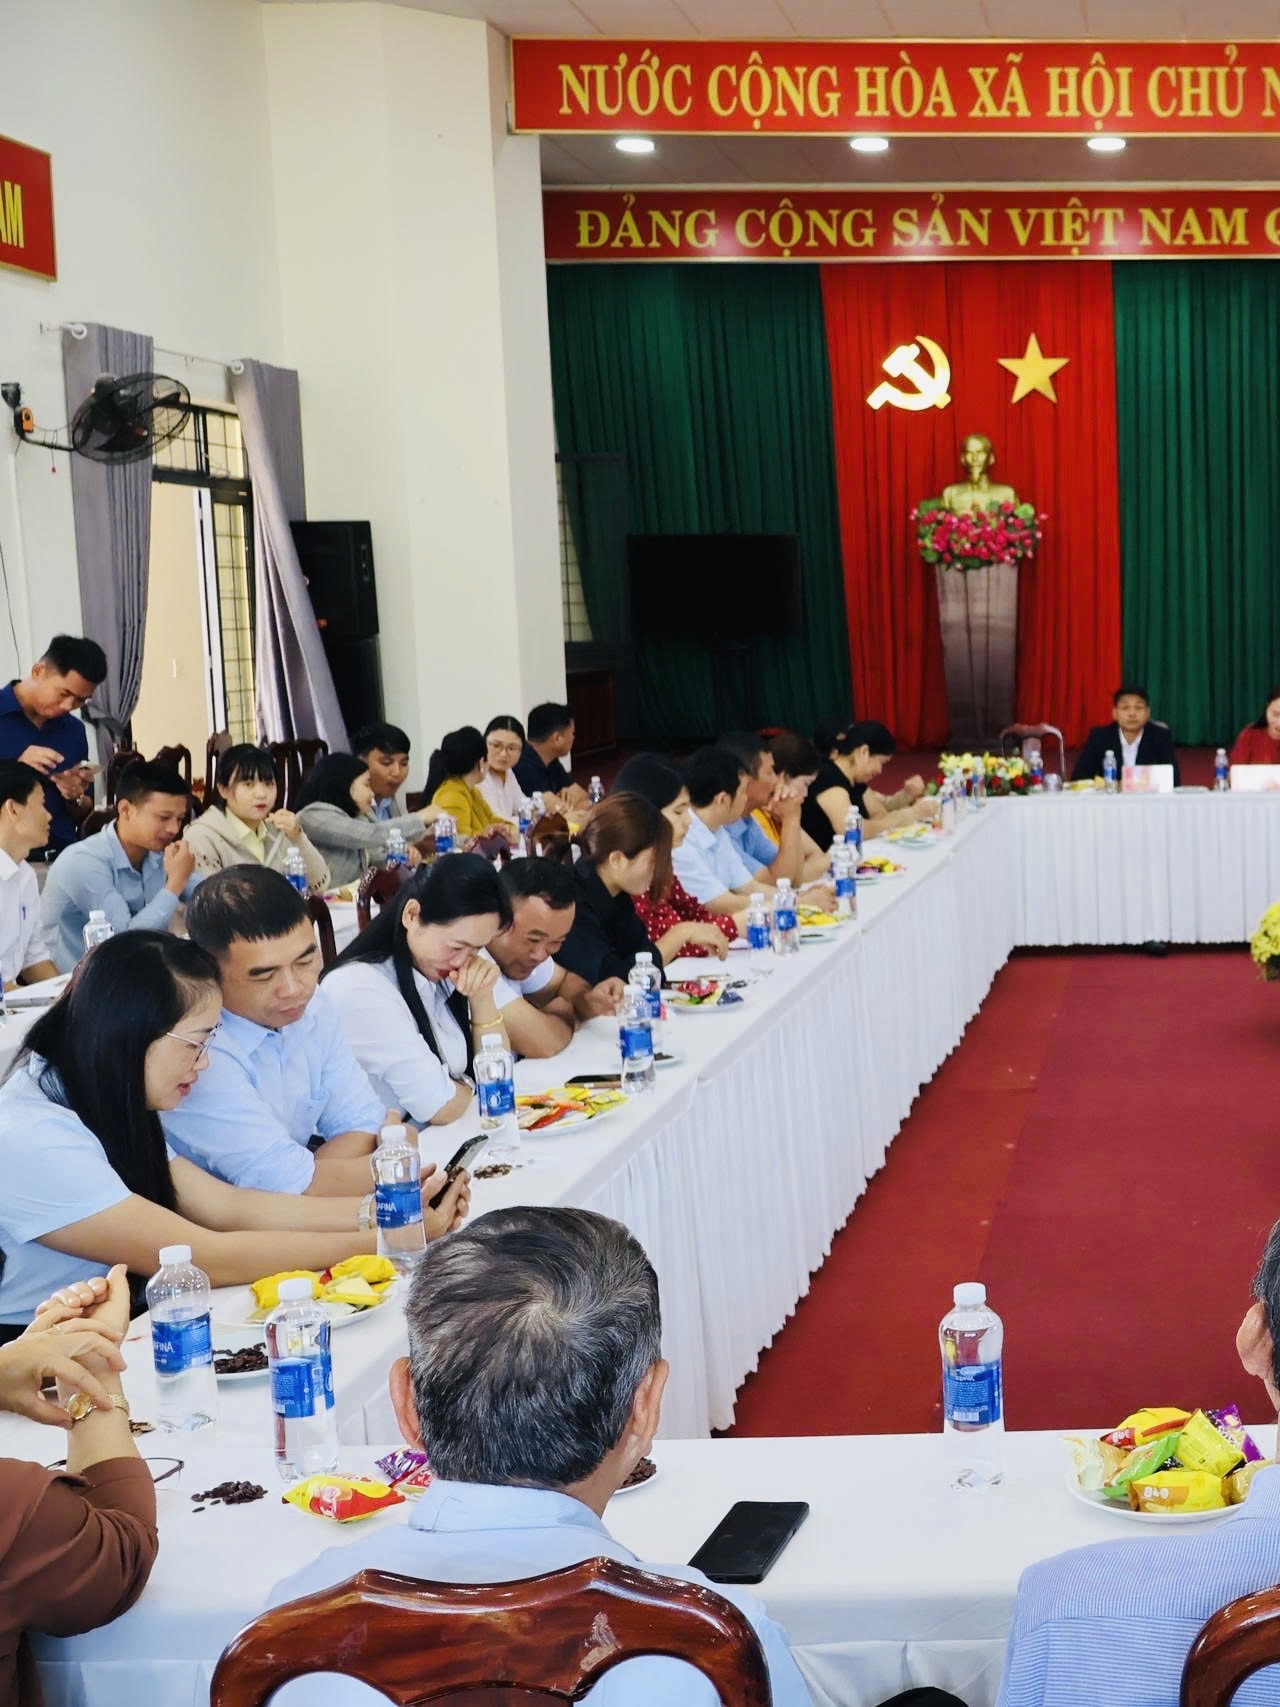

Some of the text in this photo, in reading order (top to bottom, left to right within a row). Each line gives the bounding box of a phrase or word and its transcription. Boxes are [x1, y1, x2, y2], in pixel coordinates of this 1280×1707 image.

[558, 51, 693, 116] NƯỚC
[707, 52, 840, 130] CỘNG
[854, 51, 957, 118] HÒA
[968, 53, 1031, 117] XÃ
[1046, 52, 1134, 131] HỘI
[1147, 45, 1247, 119] CHỦ
[577, 193, 717, 249] ĐẢNG
[736, 200, 877, 257] CỘNG
[892, 192, 990, 248] SẢN
[1010, 197, 1126, 256] VIỆT
[1138, 207, 1250, 247] NAM
